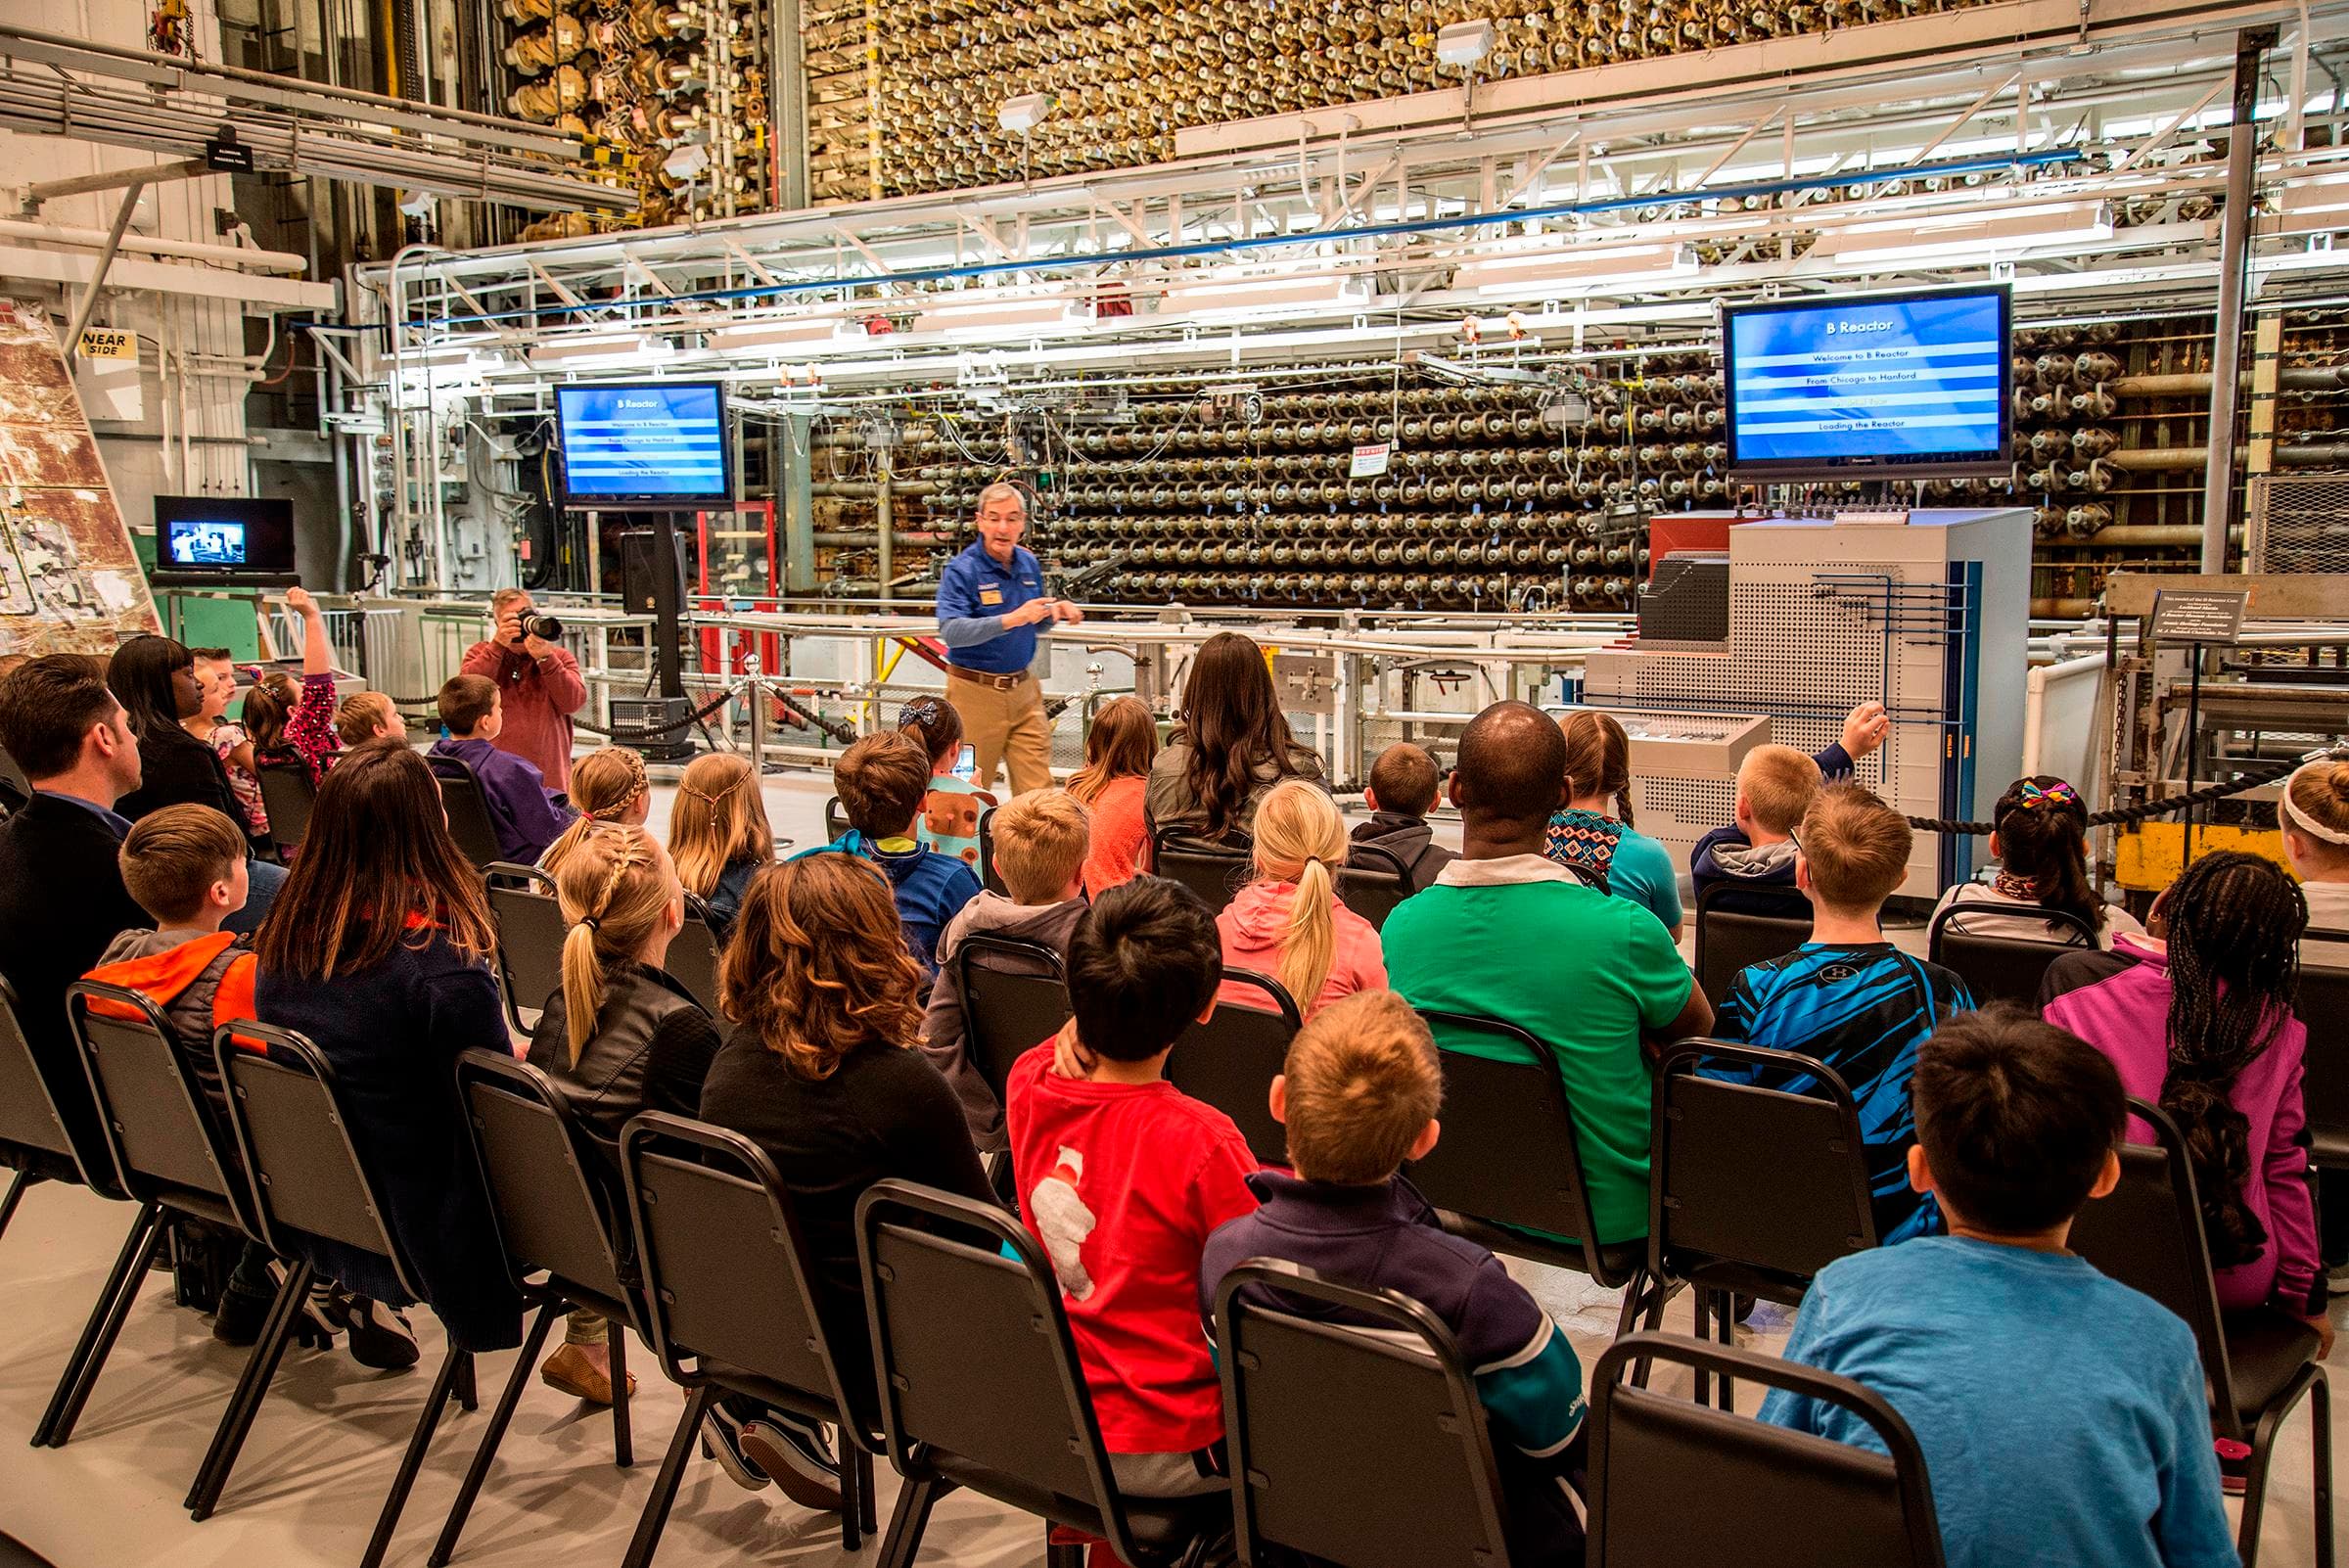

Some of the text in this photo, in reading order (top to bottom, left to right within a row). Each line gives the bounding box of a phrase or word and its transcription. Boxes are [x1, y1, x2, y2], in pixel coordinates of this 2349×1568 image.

[1826, 320, 1894, 335] B Reactor
[81, 333, 126, 346] NEAR
[89, 346, 118, 355] SIDE
[1830, 376, 1865, 385] Chicago
[1879, 372, 1916, 381] Hanford
[625, 398, 658, 408] Reactor
[1819, 422, 1853, 431] Loading
